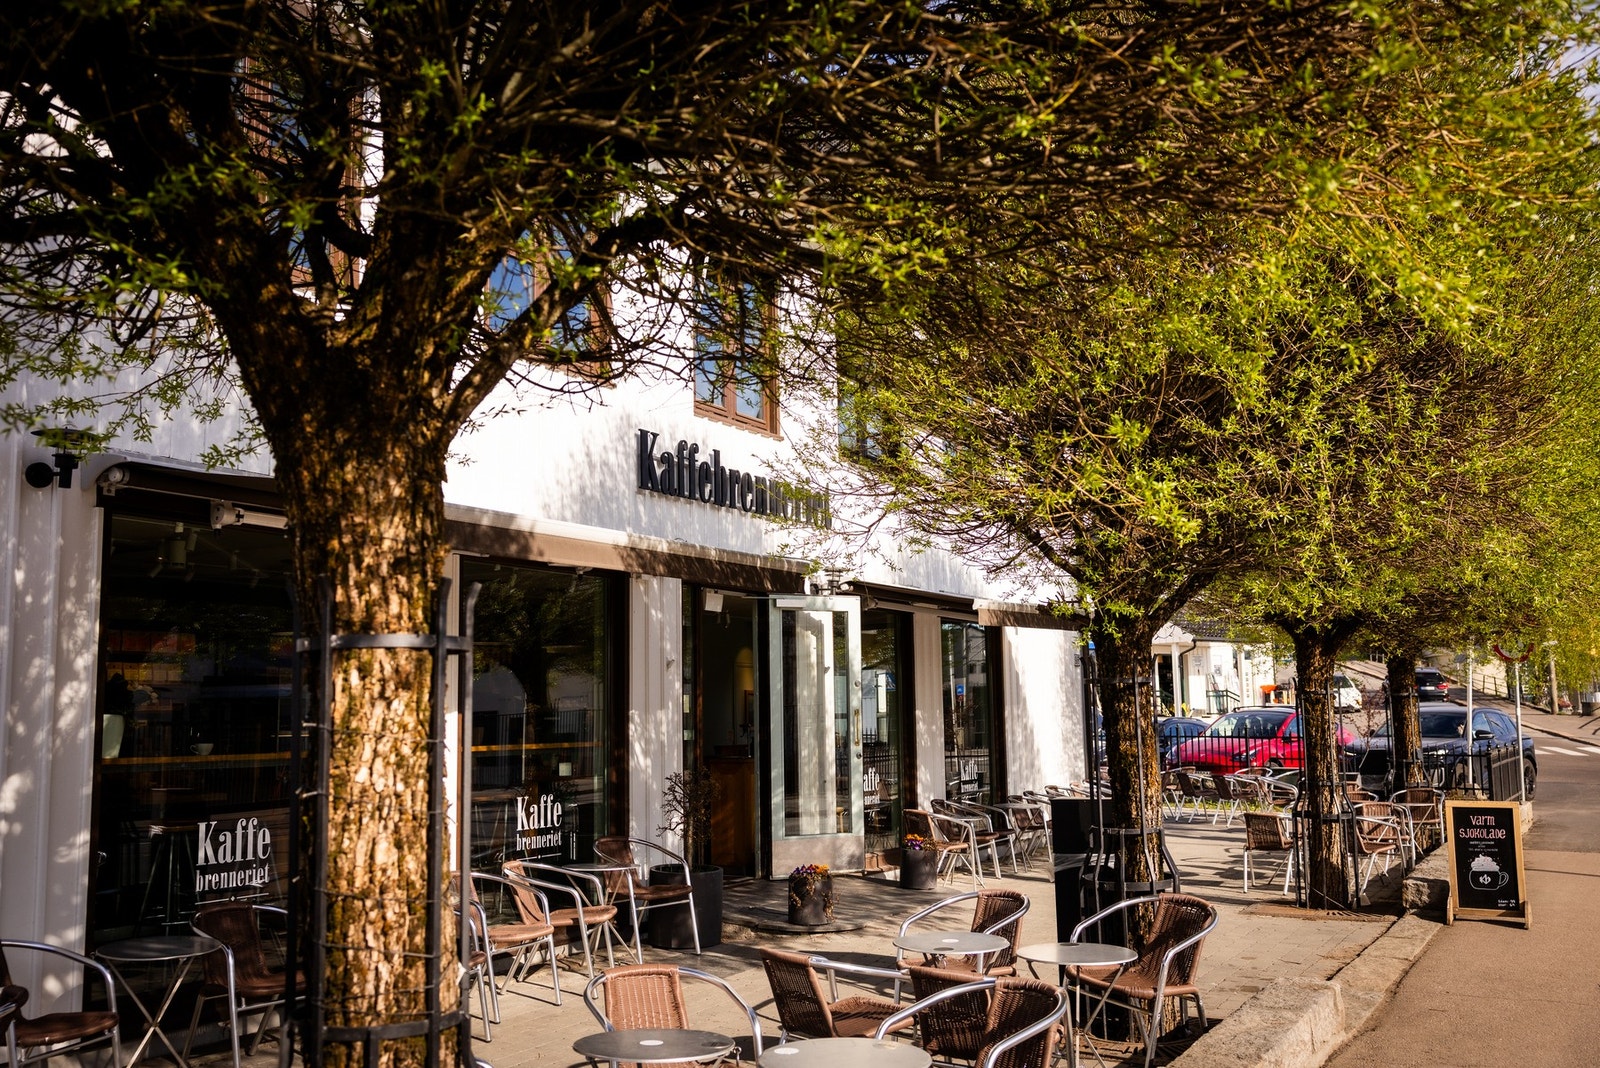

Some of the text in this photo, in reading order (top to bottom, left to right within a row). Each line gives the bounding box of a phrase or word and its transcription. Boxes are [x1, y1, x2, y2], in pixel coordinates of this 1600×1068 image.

[863, 767, 880, 792] affe
[516, 793, 562, 831] Kaffe
[1469, 815, 1495, 826] varm
[196, 817, 271, 867] Kaffe
[516, 830, 562, 851] brenneriet
[195, 863, 270, 892] brenneriet
